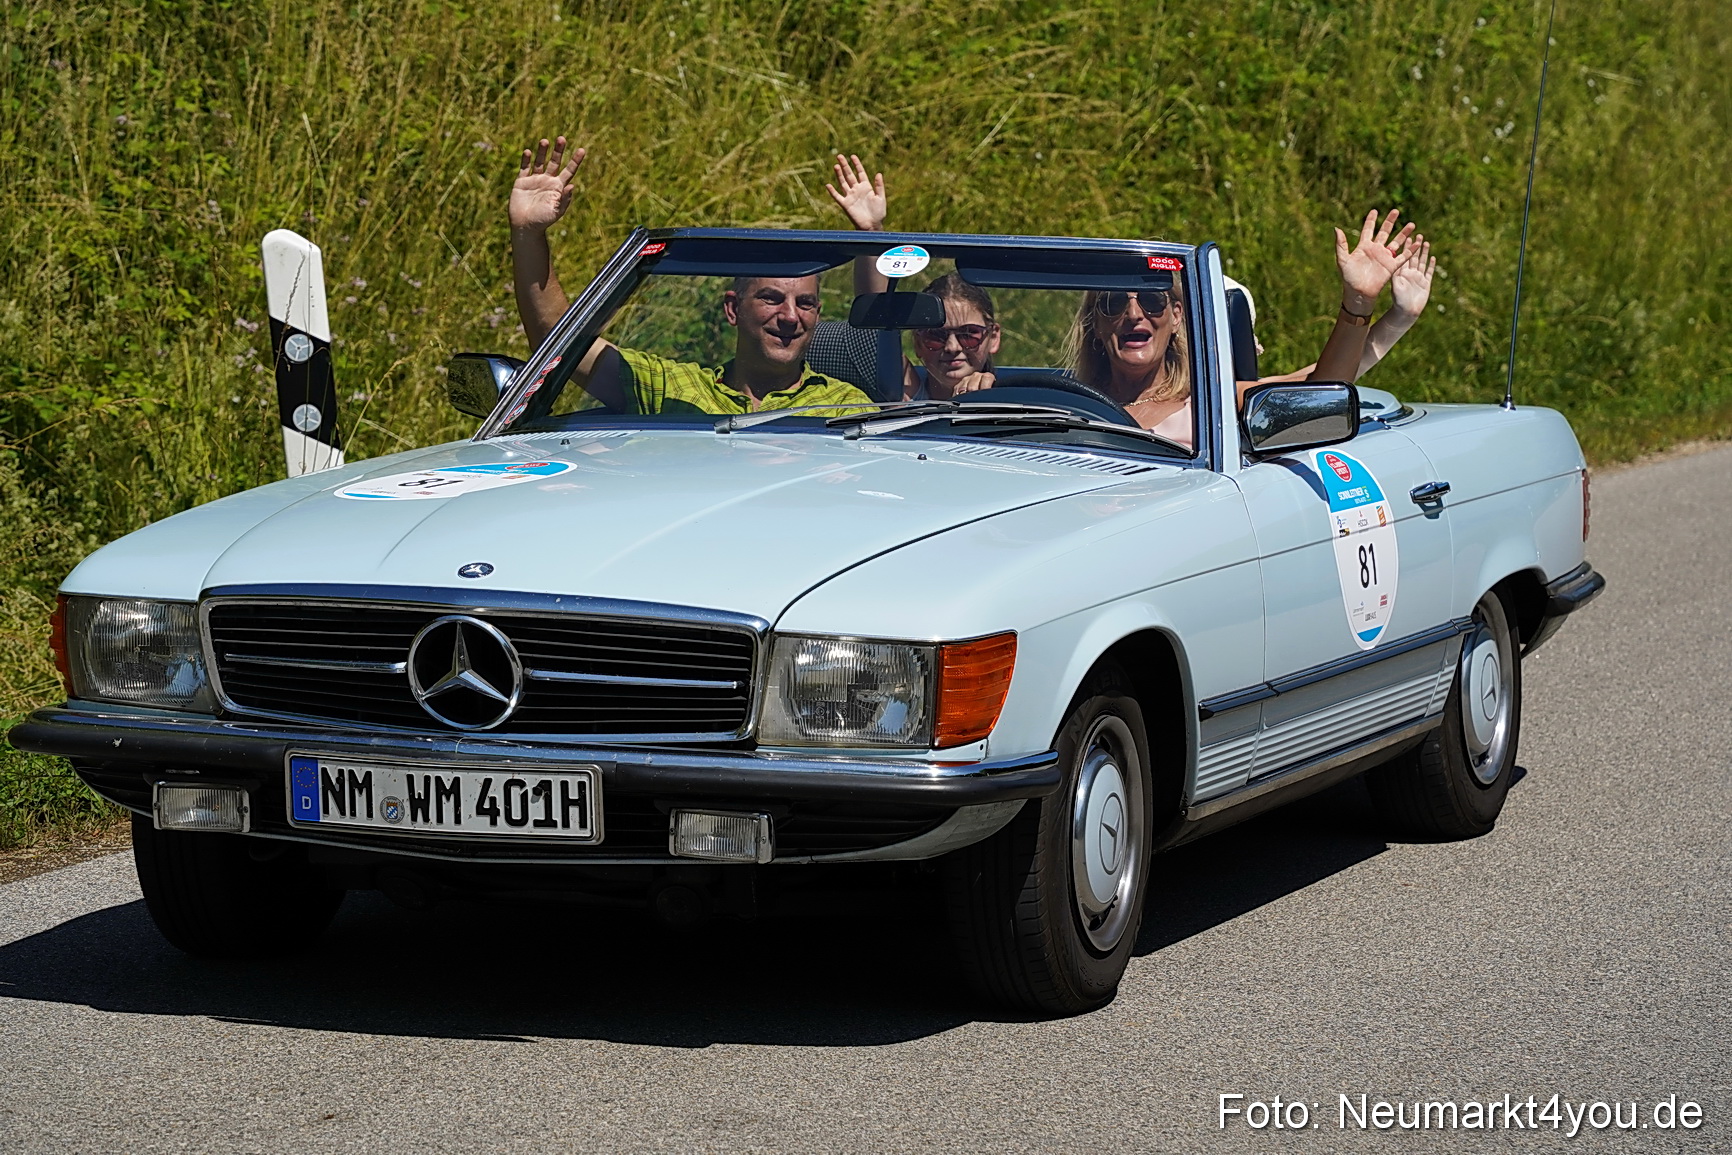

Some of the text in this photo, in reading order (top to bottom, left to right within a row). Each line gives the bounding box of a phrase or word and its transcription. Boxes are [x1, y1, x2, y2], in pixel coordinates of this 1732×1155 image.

[1358, 542, 1378, 589] 81
[301, 796, 312, 810] D
[320, 766, 374, 820] NM
[406, 773, 462, 826] WM
[475, 777, 588, 830] 401H
